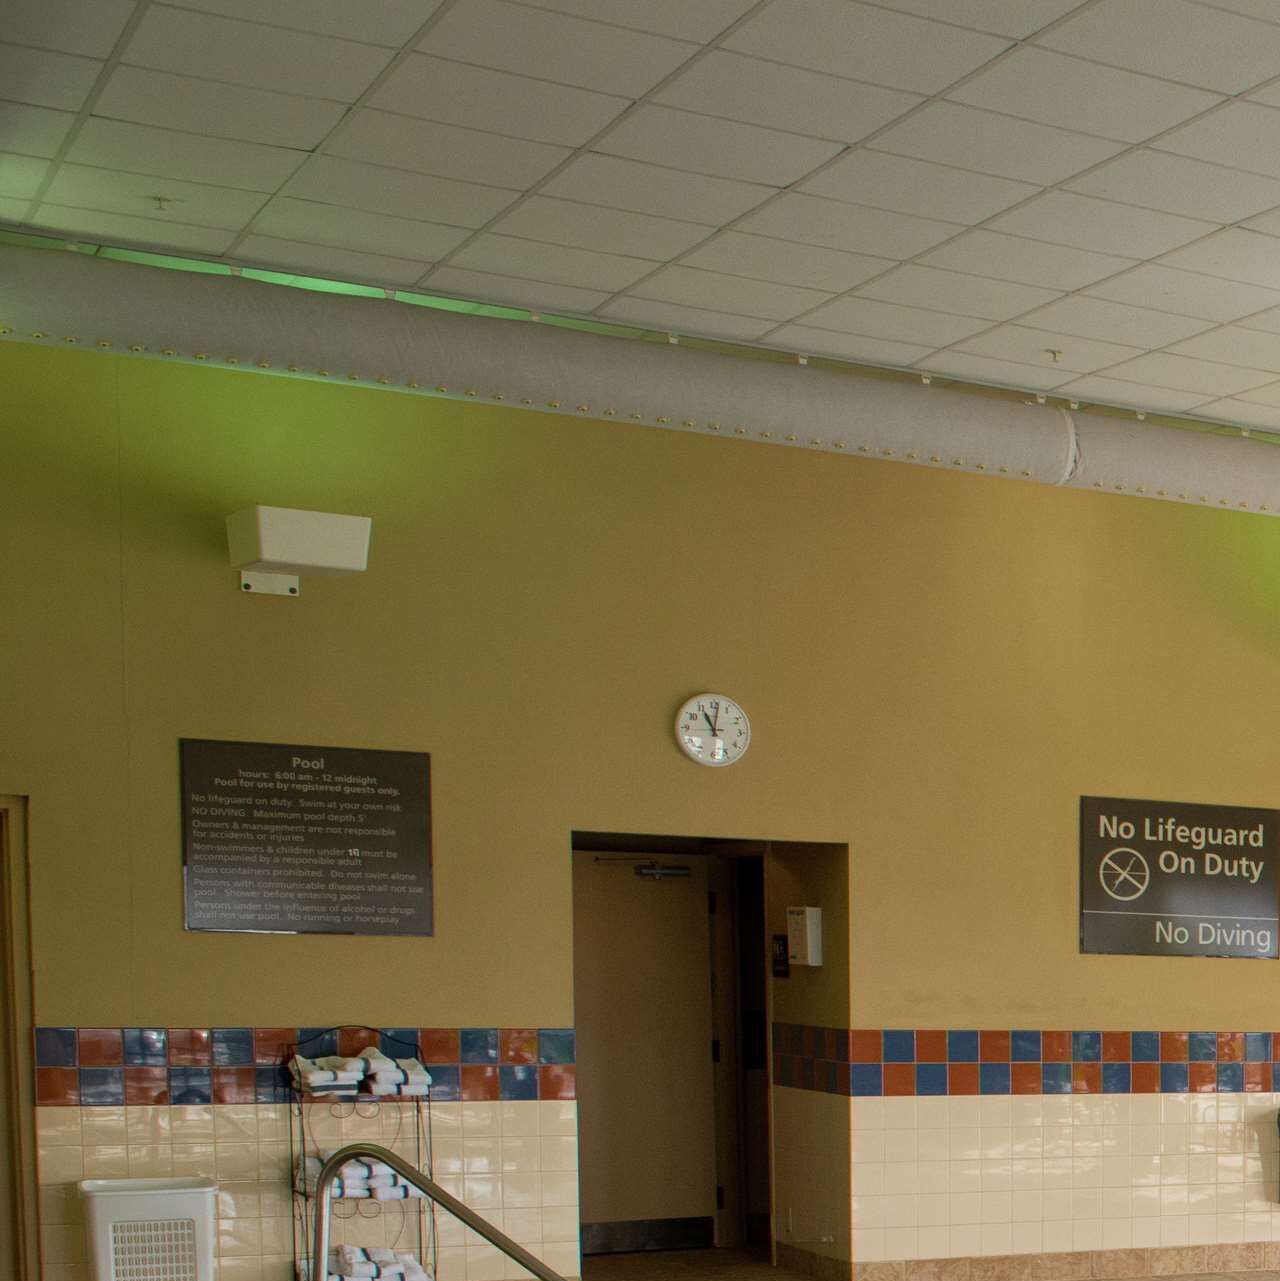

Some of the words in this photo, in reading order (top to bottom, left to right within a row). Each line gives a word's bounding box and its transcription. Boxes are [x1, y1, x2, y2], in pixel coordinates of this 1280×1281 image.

[292, 756, 325, 769] Pool
[239, 769, 269, 779] hours:
[323, 774, 332, 782] 12
[335, 775, 378, 786] midnight
[214, 778, 237, 787] Pool
[240, 779, 255, 788] for
[276, 781, 290, 791] by
[292, 783, 341, 793] registered
[343, 786, 376, 795] guests
[378, 787, 400, 797] only.
[192, 793, 206, 802] No
[208, 794, 253, 806] lifeguard
[299, 799, 325, 809] Swim
[327, 801, 337, 809] at
[339, 803, 360, 811] your
[192, 807, 208, 816] NO
[254, 810, 301, 820] Maximum
[303, 813, 326, 823] pool
[327, 814, 356, 824] depth
[192, 819, 230, 830] Owners
[232, 821, 240, 830] &
[242, 824, 305, 833] management
[325, 826, 343, 834] not
[344, 827, 397, 838] responsible
[1098, 814, 1135, 839] No
[1144, 816, 1264, 849] Lifeguard
[1159, 851, 1195, 875] On
[1204, 853, 1264, 884] Duty
[1155, 920, 1190, 944] No
[1198, 922, 1272, 953] Diving
